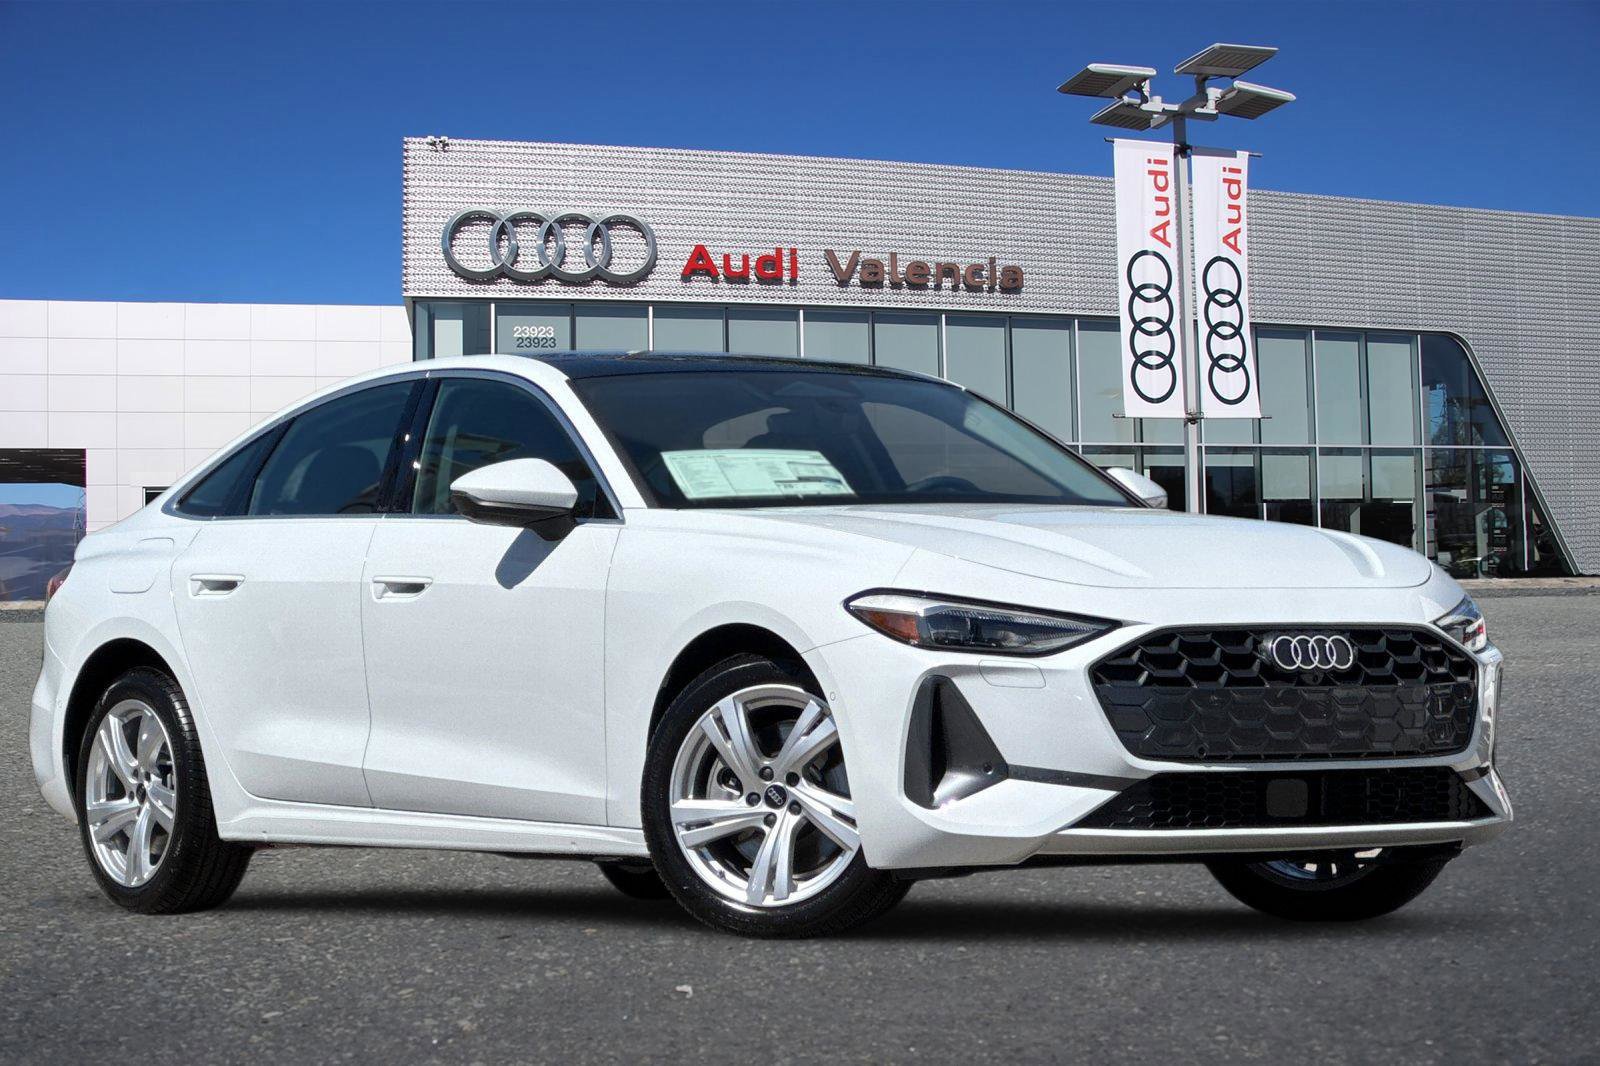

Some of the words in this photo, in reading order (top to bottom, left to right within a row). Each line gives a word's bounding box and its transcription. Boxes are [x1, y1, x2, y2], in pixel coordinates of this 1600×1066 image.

[1147, 158, 1171, 249] Audi
[1222, 166, 1242, 256] Audi
[681, 244, 798, 281] Audi
[824, 249, 1024, 289] Valencia
[513, 326, 554, 338] 23923
[516, 337, 557, 348] 23923
